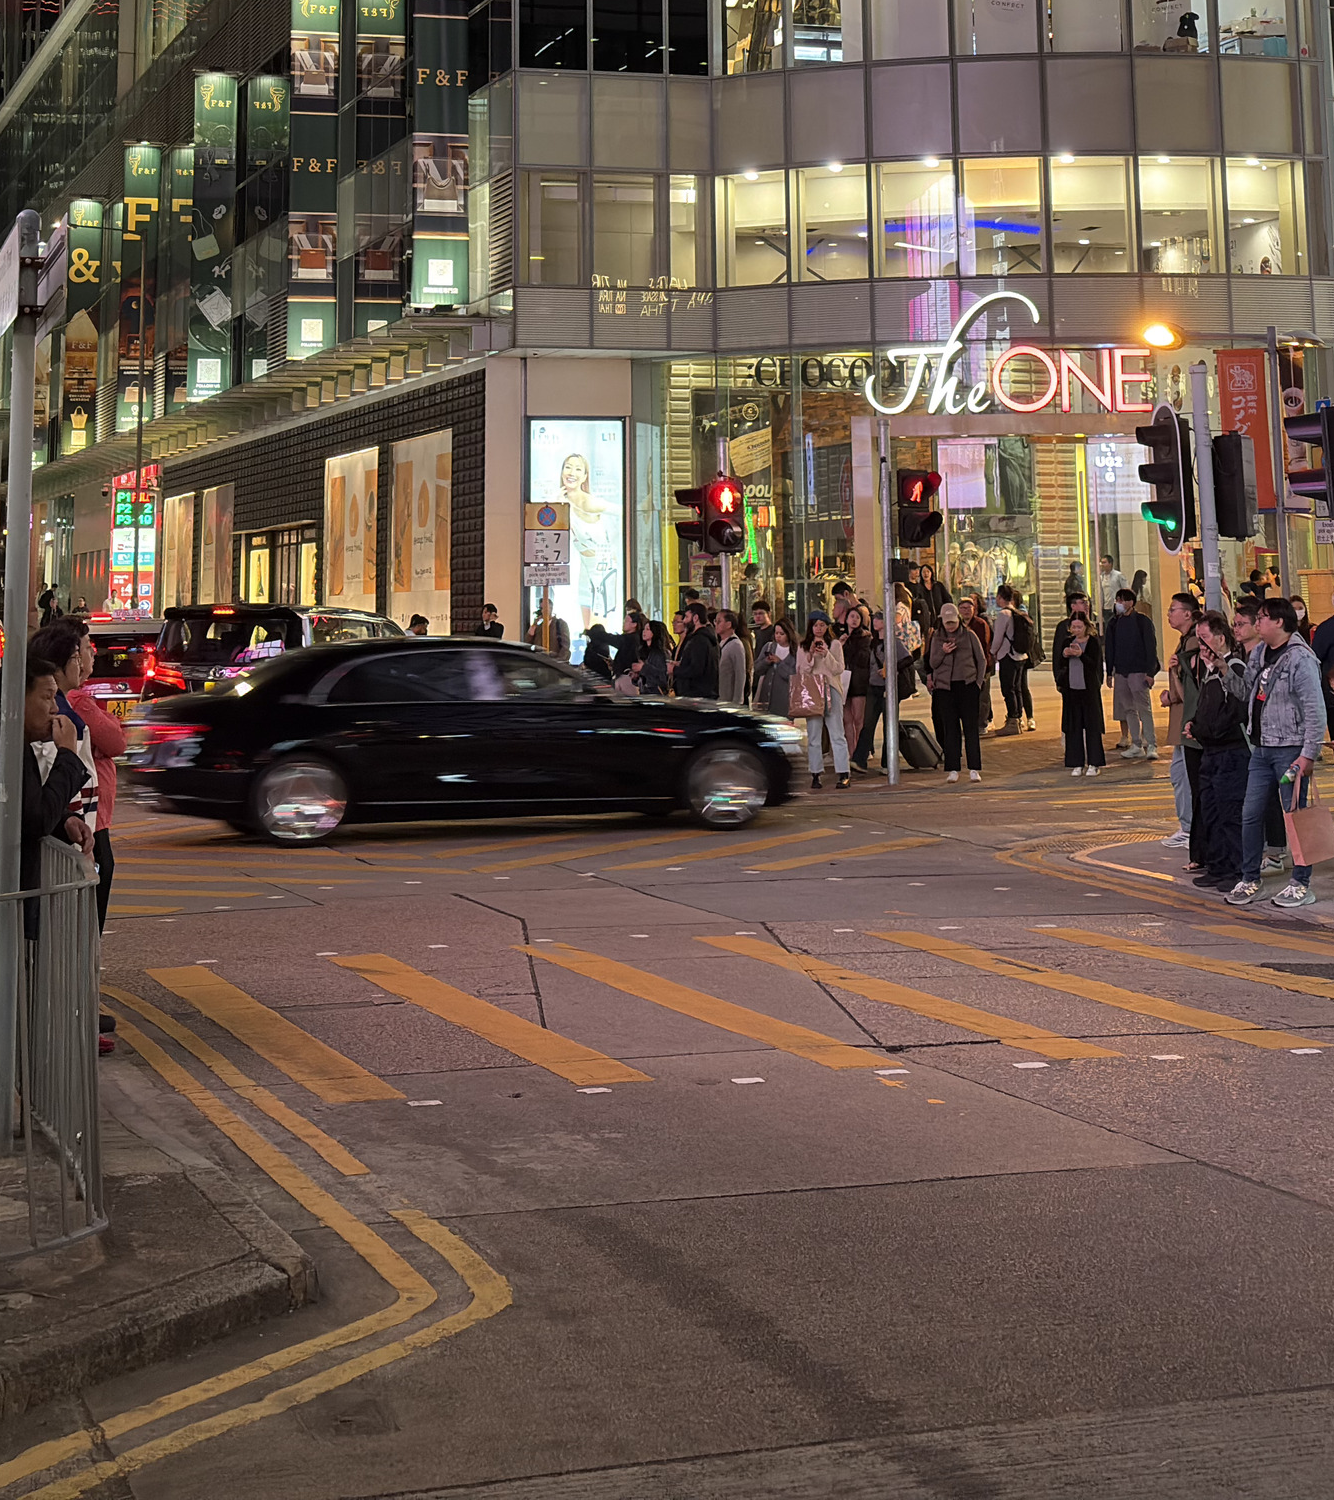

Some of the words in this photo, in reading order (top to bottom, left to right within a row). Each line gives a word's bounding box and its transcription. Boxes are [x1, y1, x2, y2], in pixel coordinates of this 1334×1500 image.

[865, 291, 1040, 415] The
[992, 345, 1154, 414] ONE
[116, 492, 131, 503] P1
[116, 503, 132, 514] P2
[553, 533, 561, 544] 7
[553, 550, 561, 561] 7
